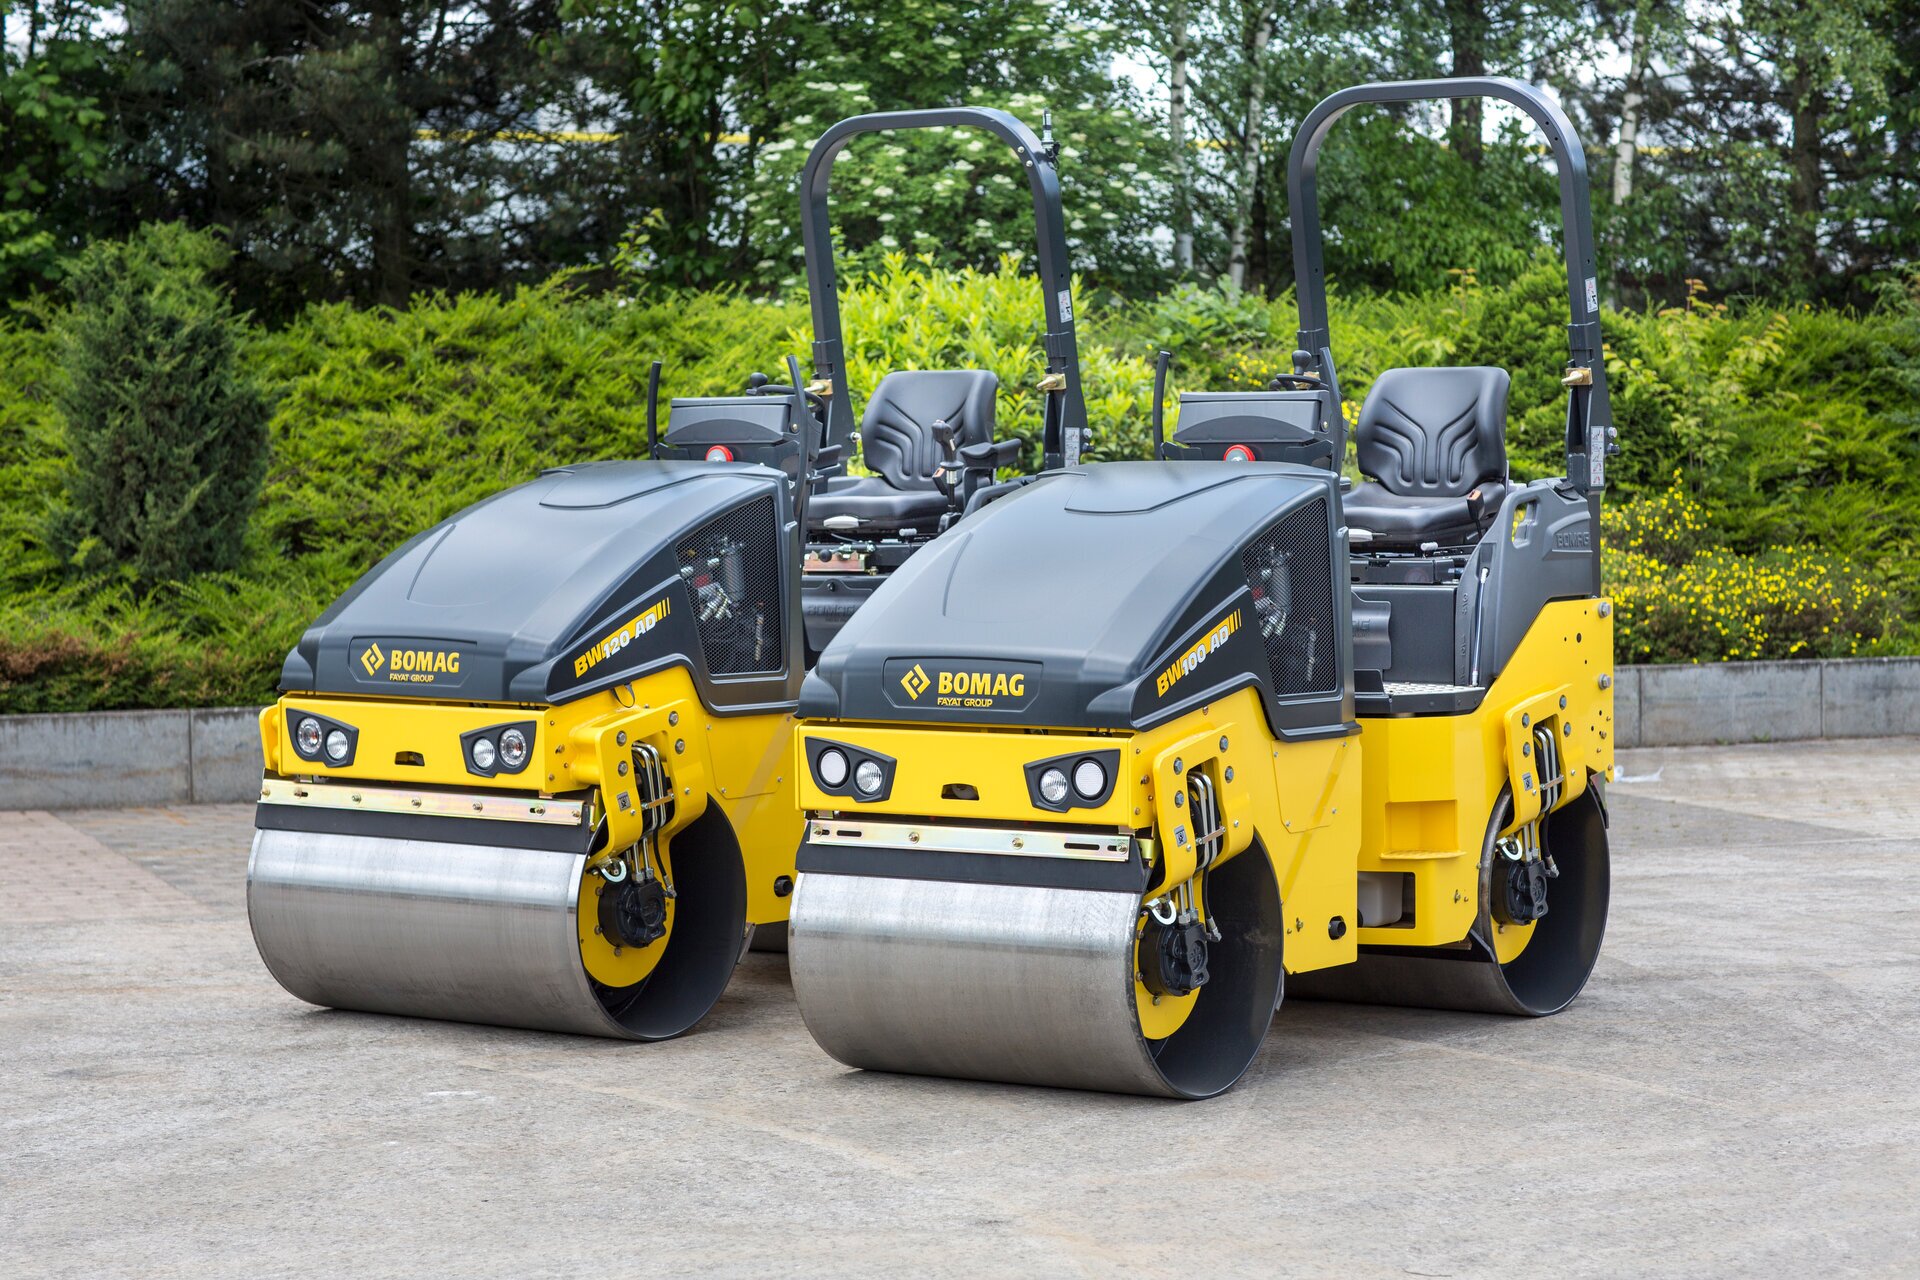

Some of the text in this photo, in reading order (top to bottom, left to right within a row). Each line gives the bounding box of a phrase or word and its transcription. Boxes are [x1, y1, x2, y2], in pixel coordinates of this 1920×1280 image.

[635, 613, 657, 639] AD
[1210, 625, 1230, 654] AD
[390, 649, 460, 673] BOMAG
[389, 672, 434, 683] FAYAT GROUP
[937, 671, 1025, 697] BOMAG
[937, 696, 993, 707] FAYAT GROUP
